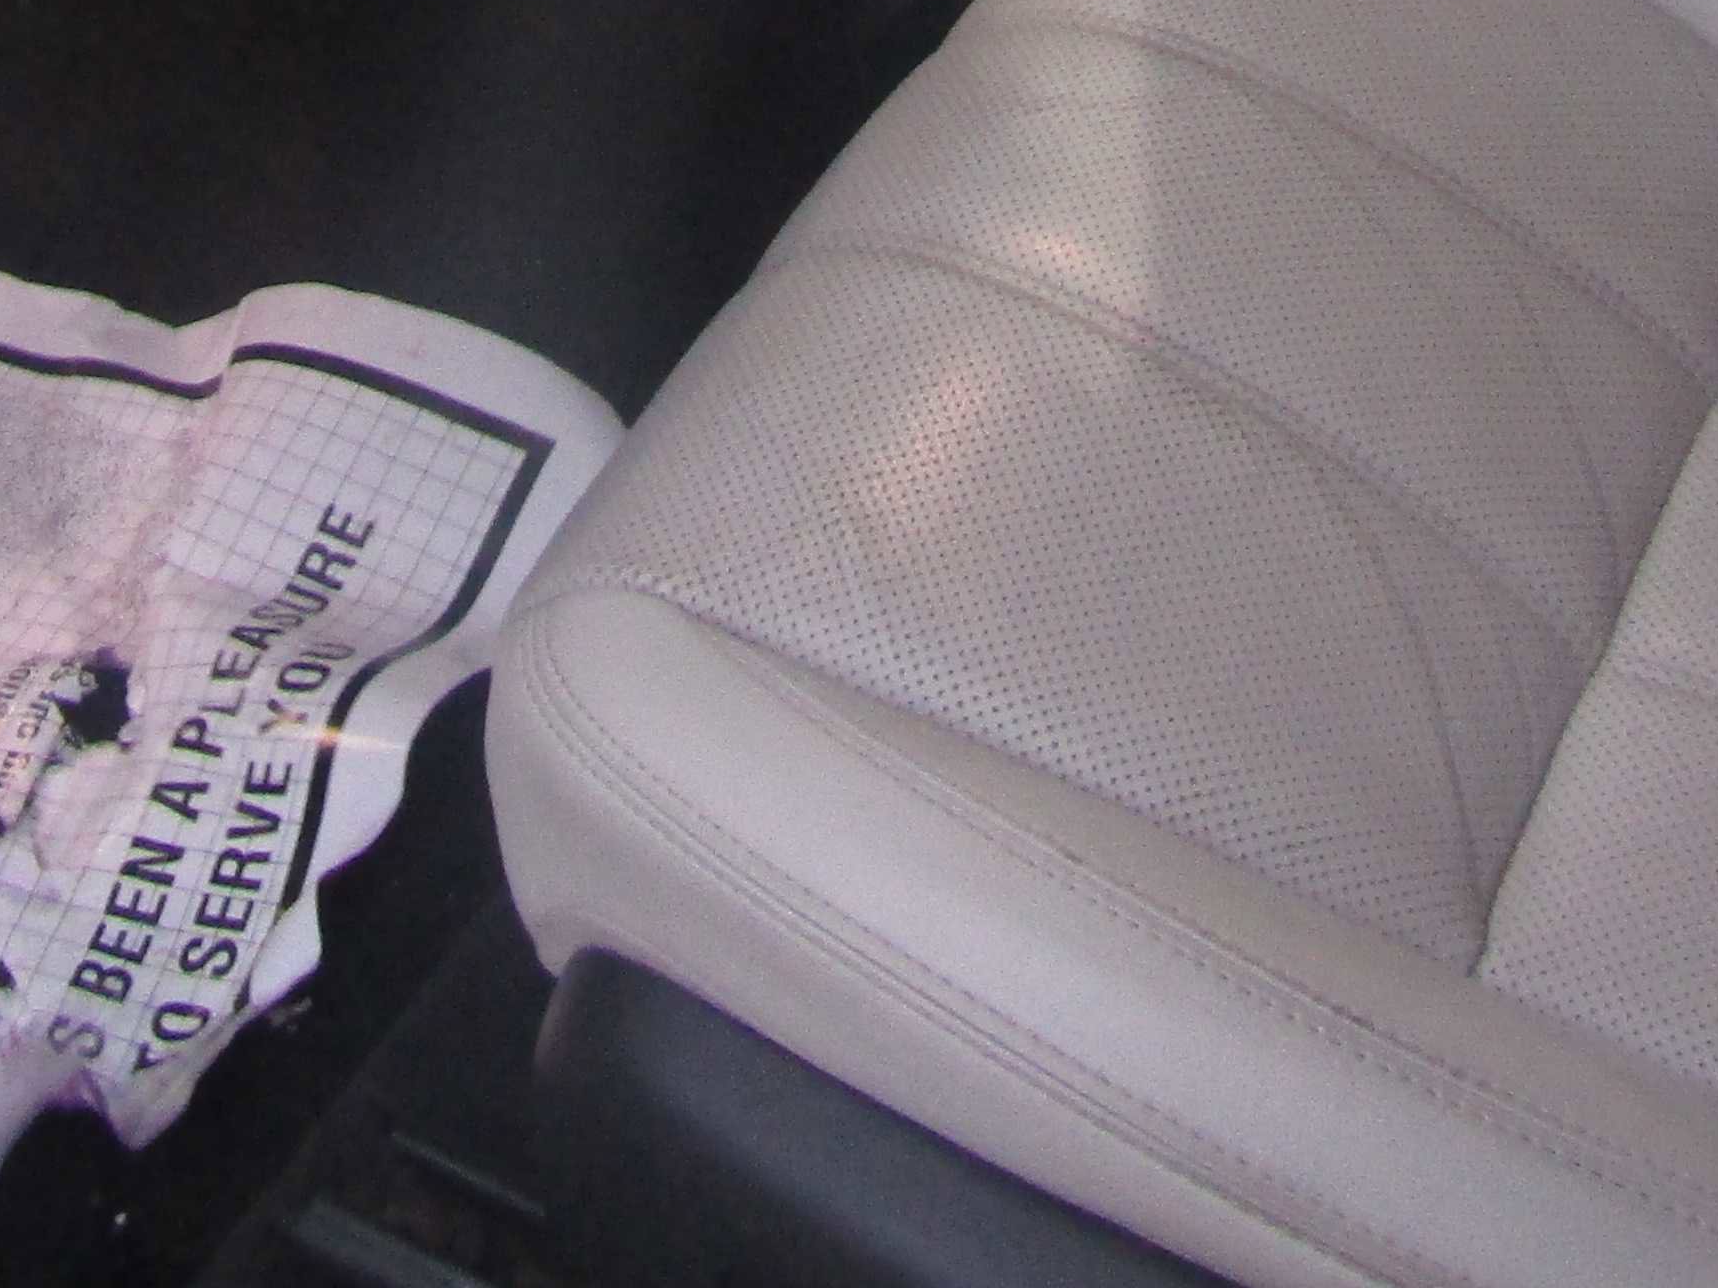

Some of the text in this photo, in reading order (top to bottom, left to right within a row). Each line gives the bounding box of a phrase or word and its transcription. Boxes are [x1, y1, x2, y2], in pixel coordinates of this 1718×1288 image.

[68, 835, 186, 1004] BEEN
[150, 781, 211, 821] A
[180, 760, 294, 981] SERVE
[259, 642, 356, 734] YOU
